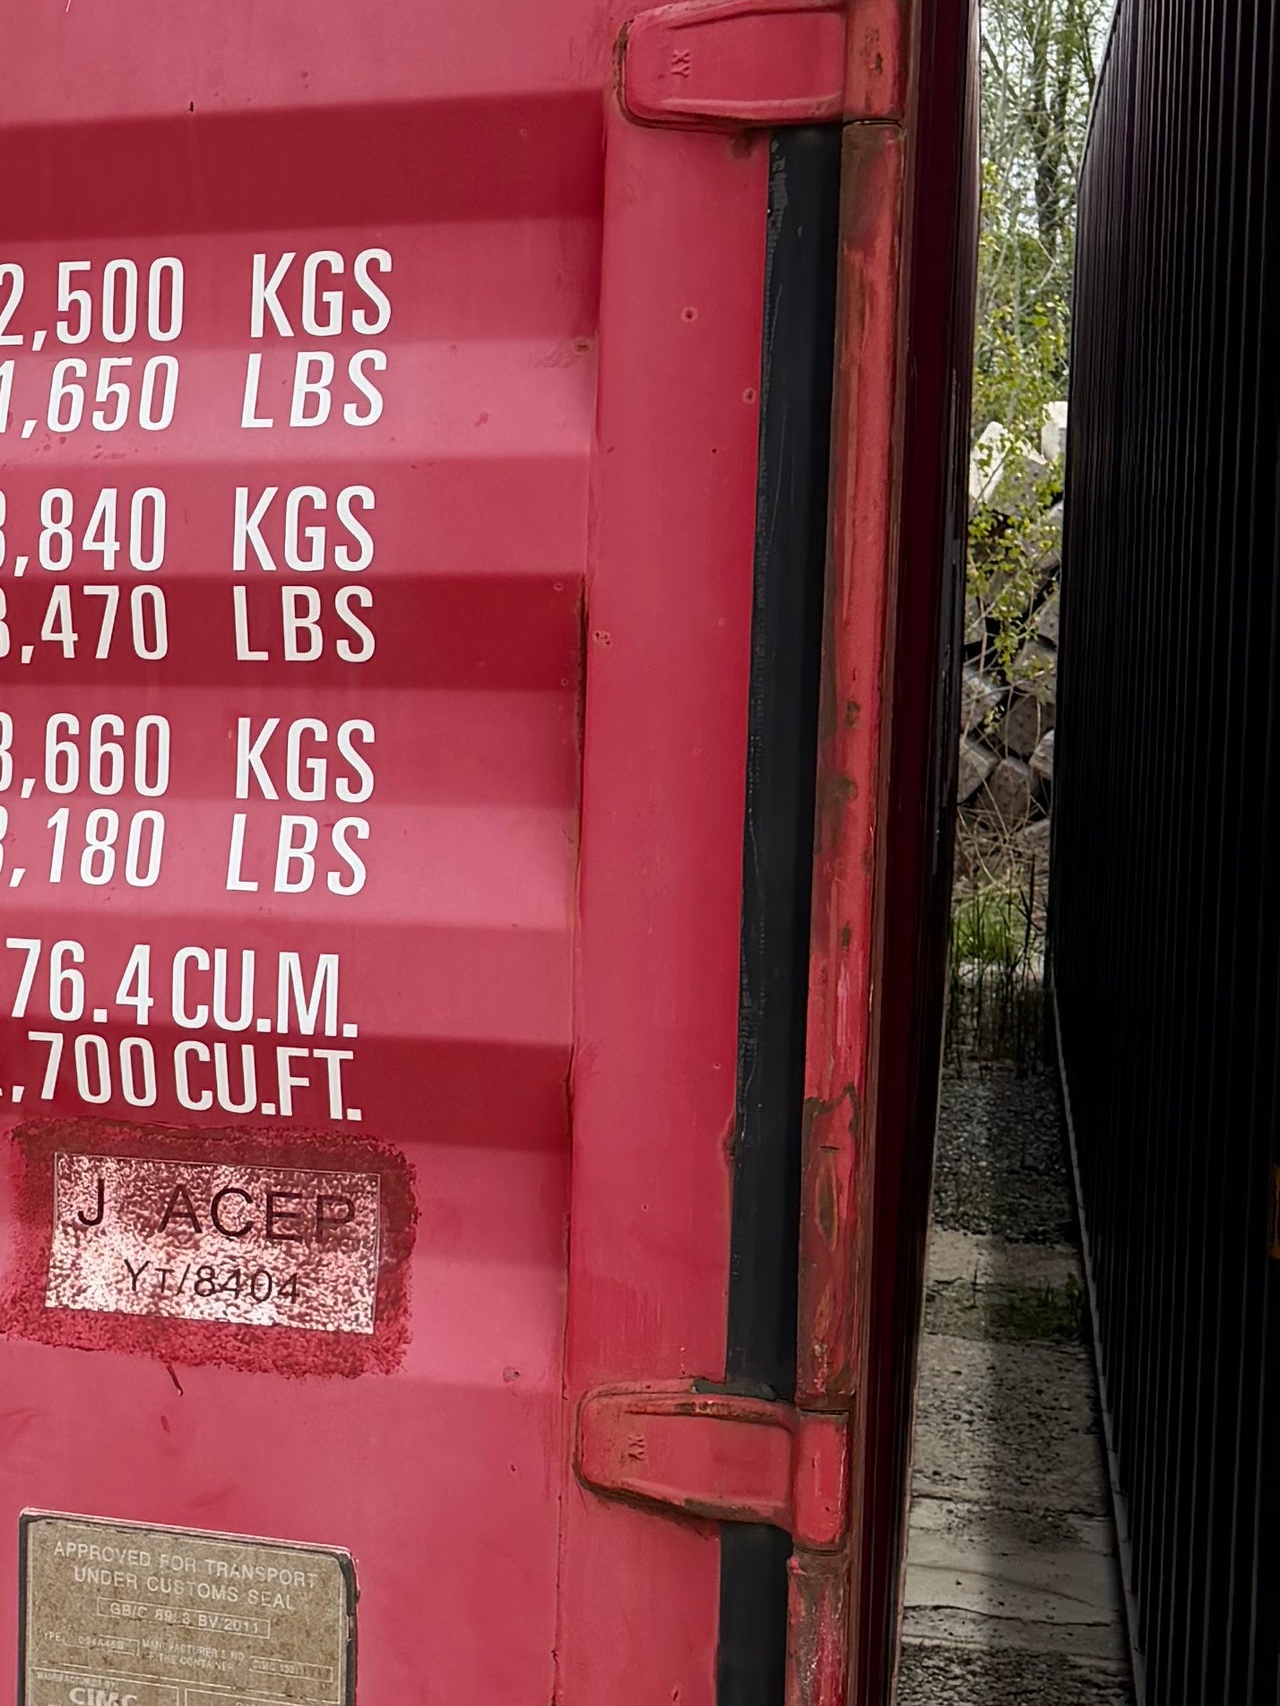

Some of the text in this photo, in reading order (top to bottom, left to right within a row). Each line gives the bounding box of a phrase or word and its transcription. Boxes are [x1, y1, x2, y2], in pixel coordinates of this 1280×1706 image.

[251, 249, 392, 337] KGS
[240, 350, 387, 428] LBS
[232, 485, 375, 572] KGS
[234, 586, 375, 662] LBS
[235, 717, 375, 803] KGS
[225, 814, 369, 895] LBS
[6, 937, 153, 1025] 76.4
[172, 946, 358, 1038] CU.M.
[175, 1040, 361, 1121] CU.FT.
[157, 1184, 357, 1249] ACEP
[54, 1539, 317, 1590] APPROVED FOR TRANSPORT
[74, 1565, 295, 1610] UNDER CUSTOMS SEAL
